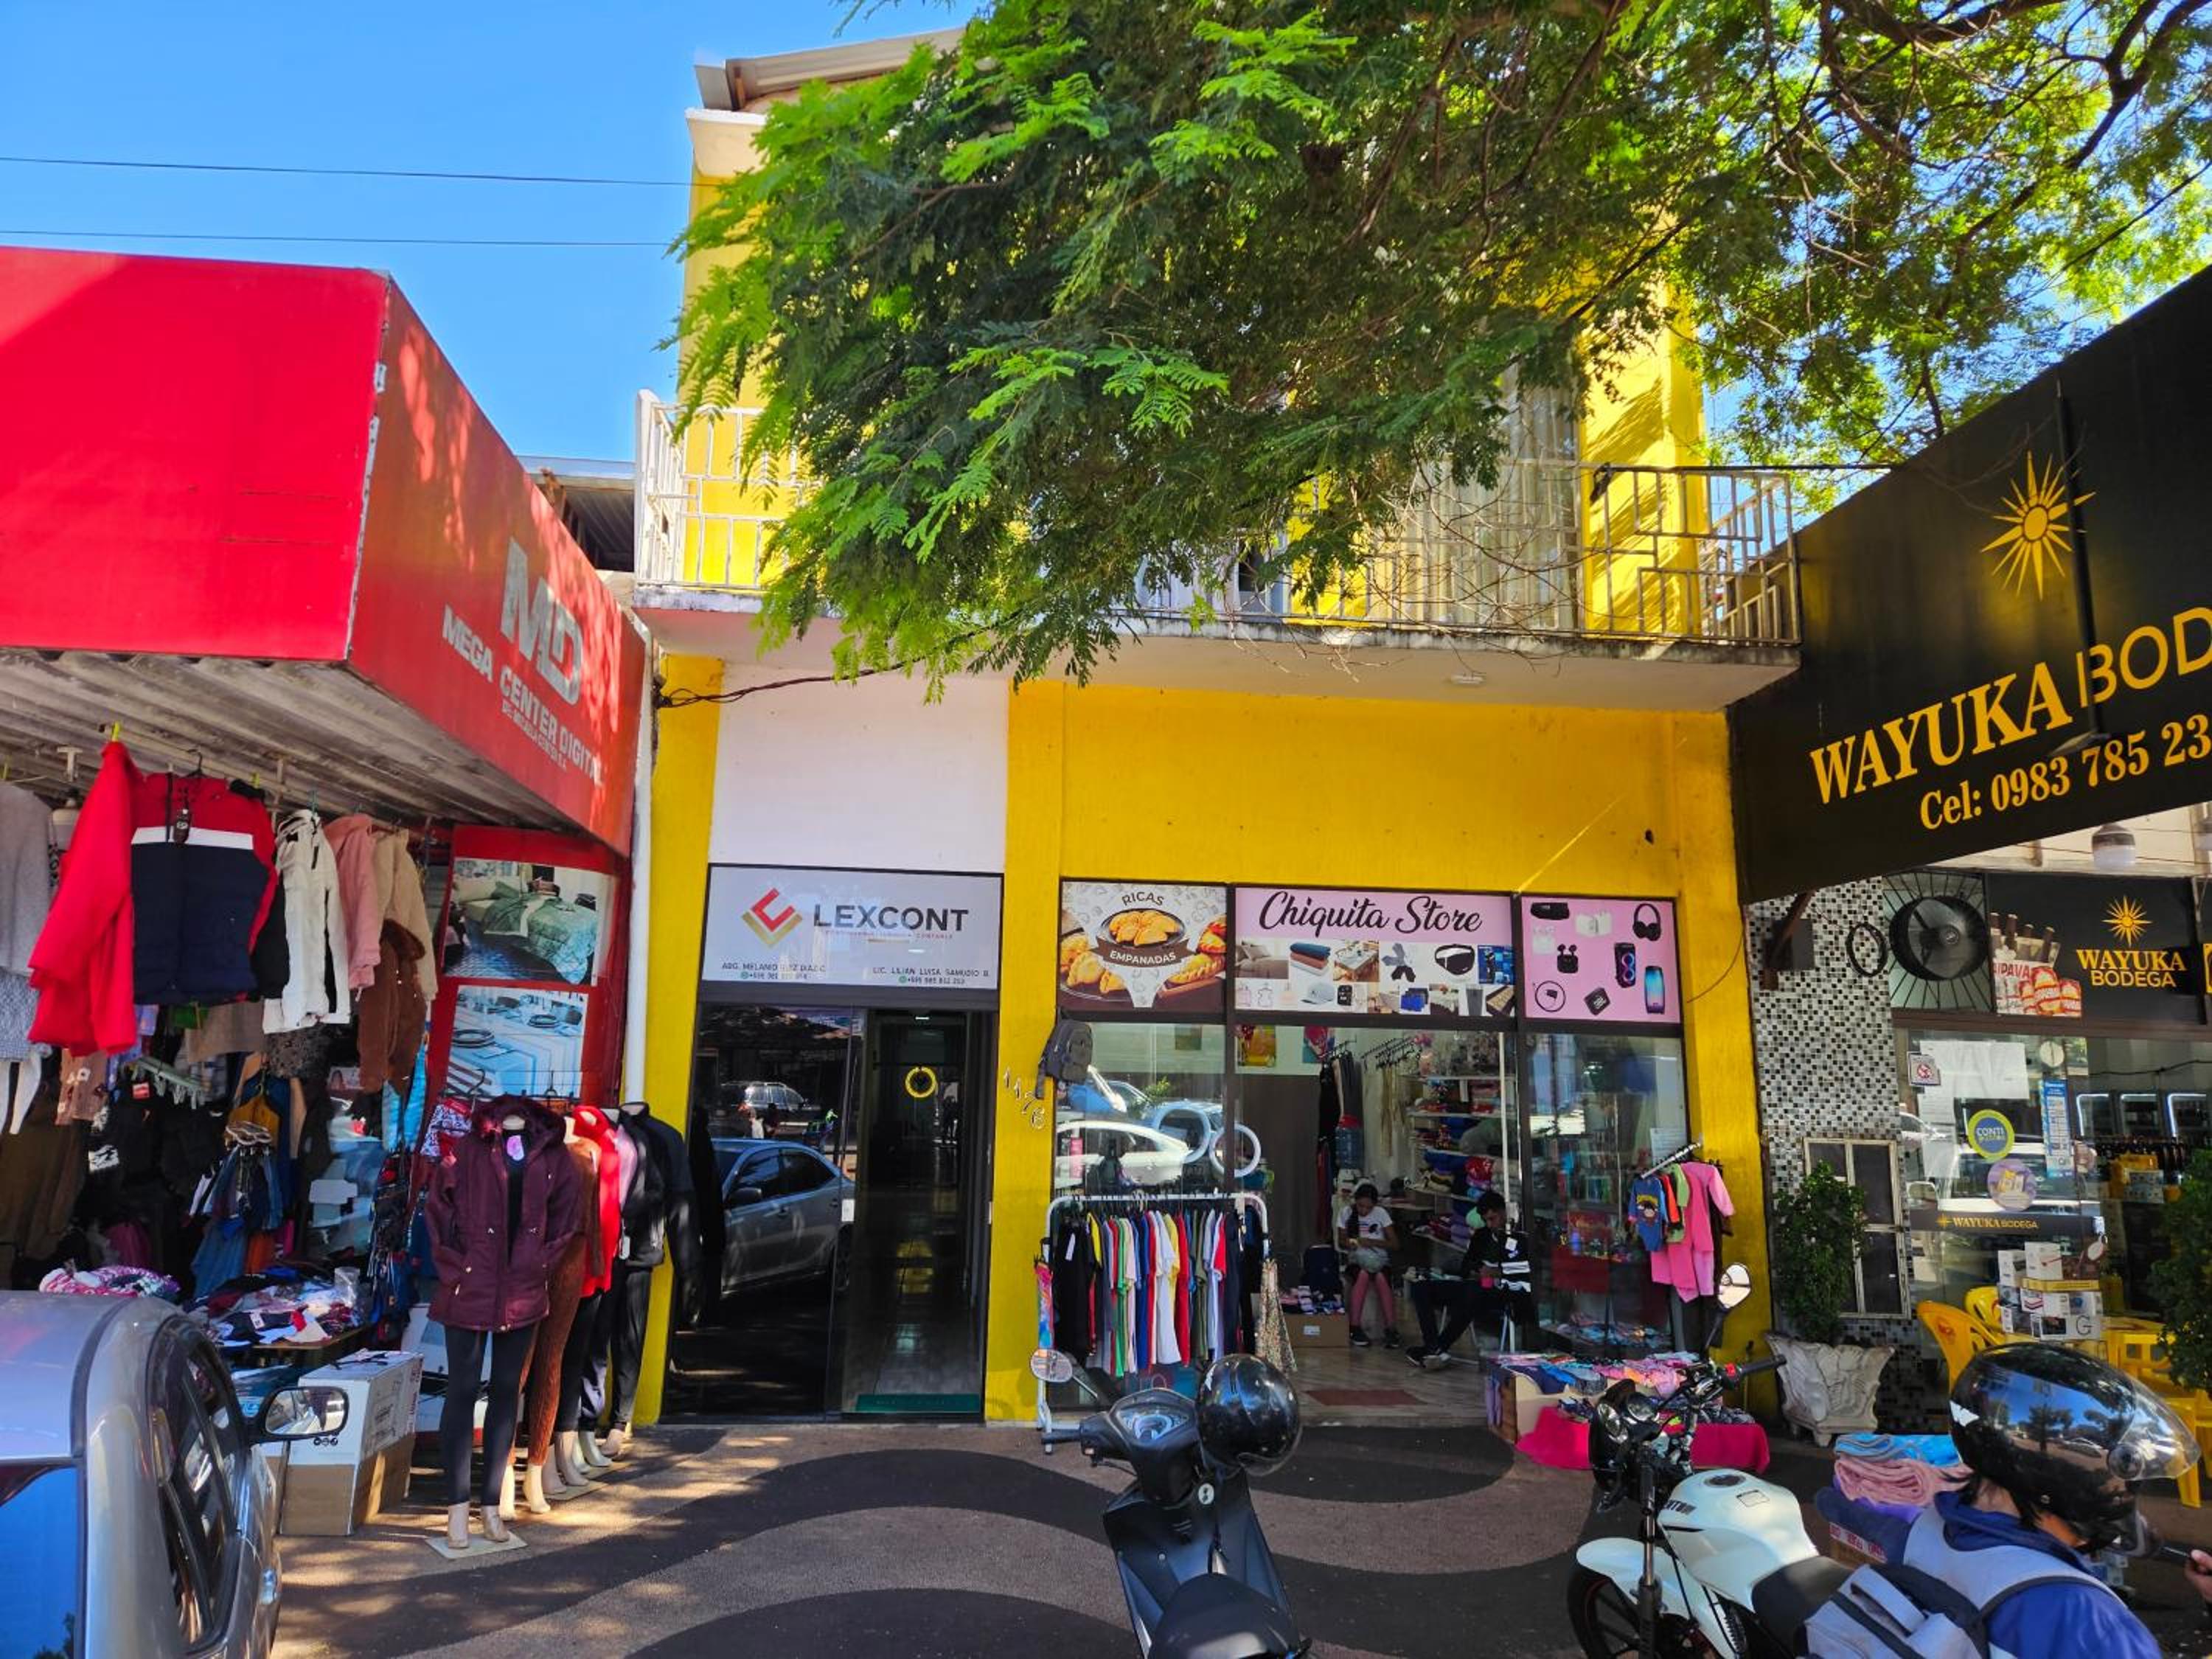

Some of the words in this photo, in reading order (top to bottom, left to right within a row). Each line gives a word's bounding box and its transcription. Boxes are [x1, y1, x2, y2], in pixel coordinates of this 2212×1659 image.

[443, 607, 494, 684] MEGA
[501, 666, 557, 743] CENTER
[1810, 661, 2073, 804] WAYUKA
[2076, 606, 2212, 709] BOD
[1920, 780, 1982, 830] Cel:
[1991, 755, 2071, 812] 0983
[2081, 729, 2149, 787] 785
[2161, 714, 2212, 768] 23
[1121, 891, 1165, 906] RICAS
[814, 904, 969, 931] LEXCONT
[1259, 891, 1390, 938] Chiquita
[1395, 895, 1483, 934] Store
[1110, 950, 1176, 965] EMPANADAS
[2077, 950, 2186, 971] WAYUKA
[2093, 971, 2176, 987] BODEGA
[1952, 1217, 2000, 1228] WAYUKA
